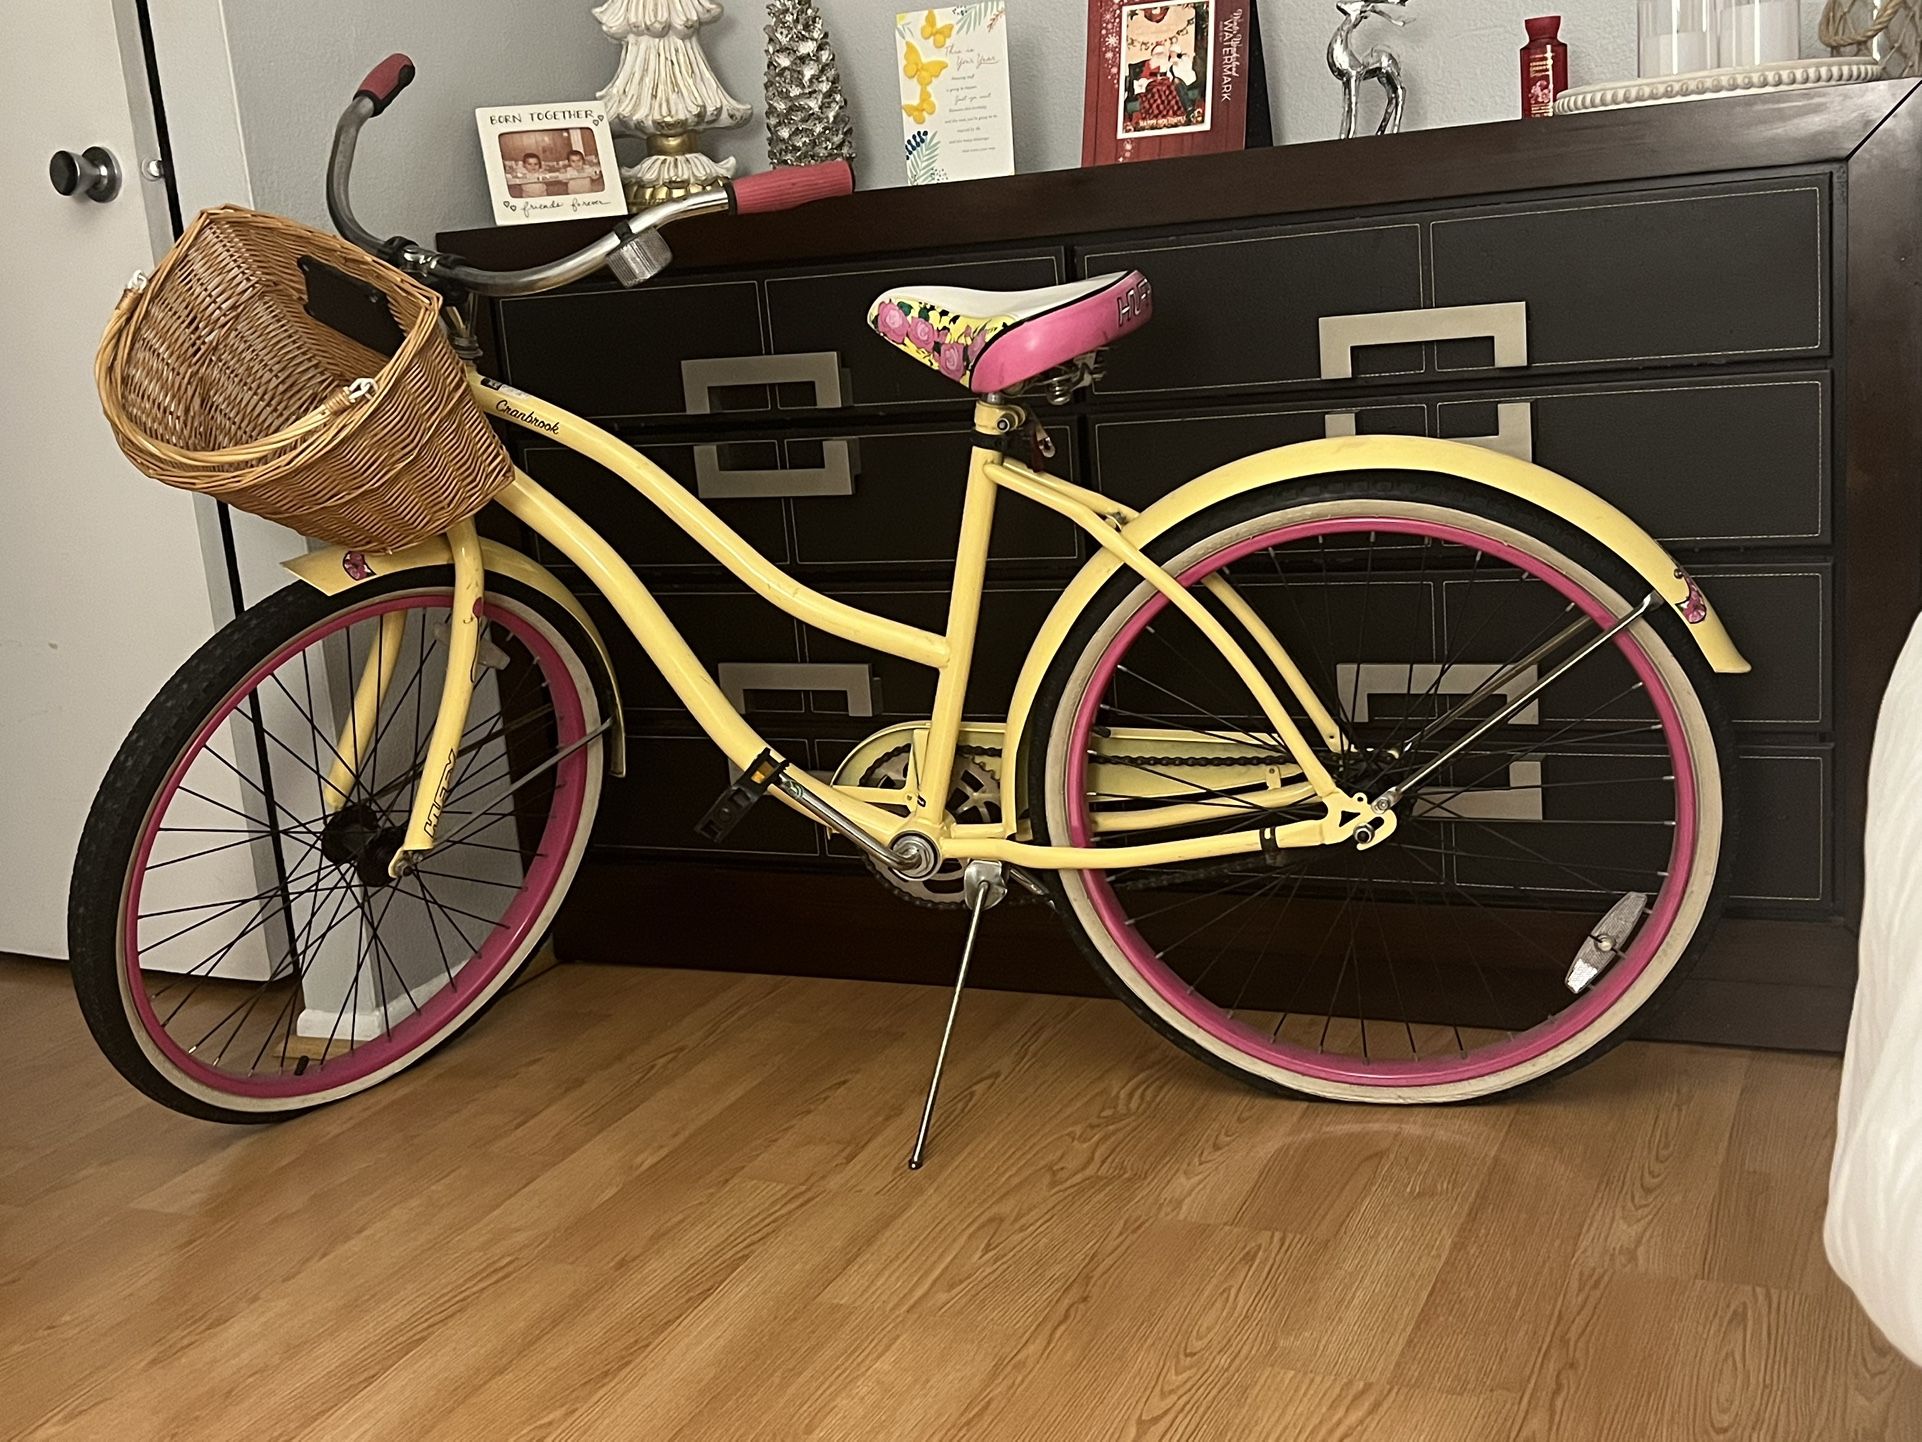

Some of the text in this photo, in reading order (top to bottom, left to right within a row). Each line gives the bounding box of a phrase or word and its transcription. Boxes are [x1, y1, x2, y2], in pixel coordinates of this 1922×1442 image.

[1221, 18, 1234, 102] WATERMARK
[489, 109, 595, 125] BORN TOGETHER
[520, 197, 612, 218] friends forever
[495, 399, 560, 435] Cranbrook
